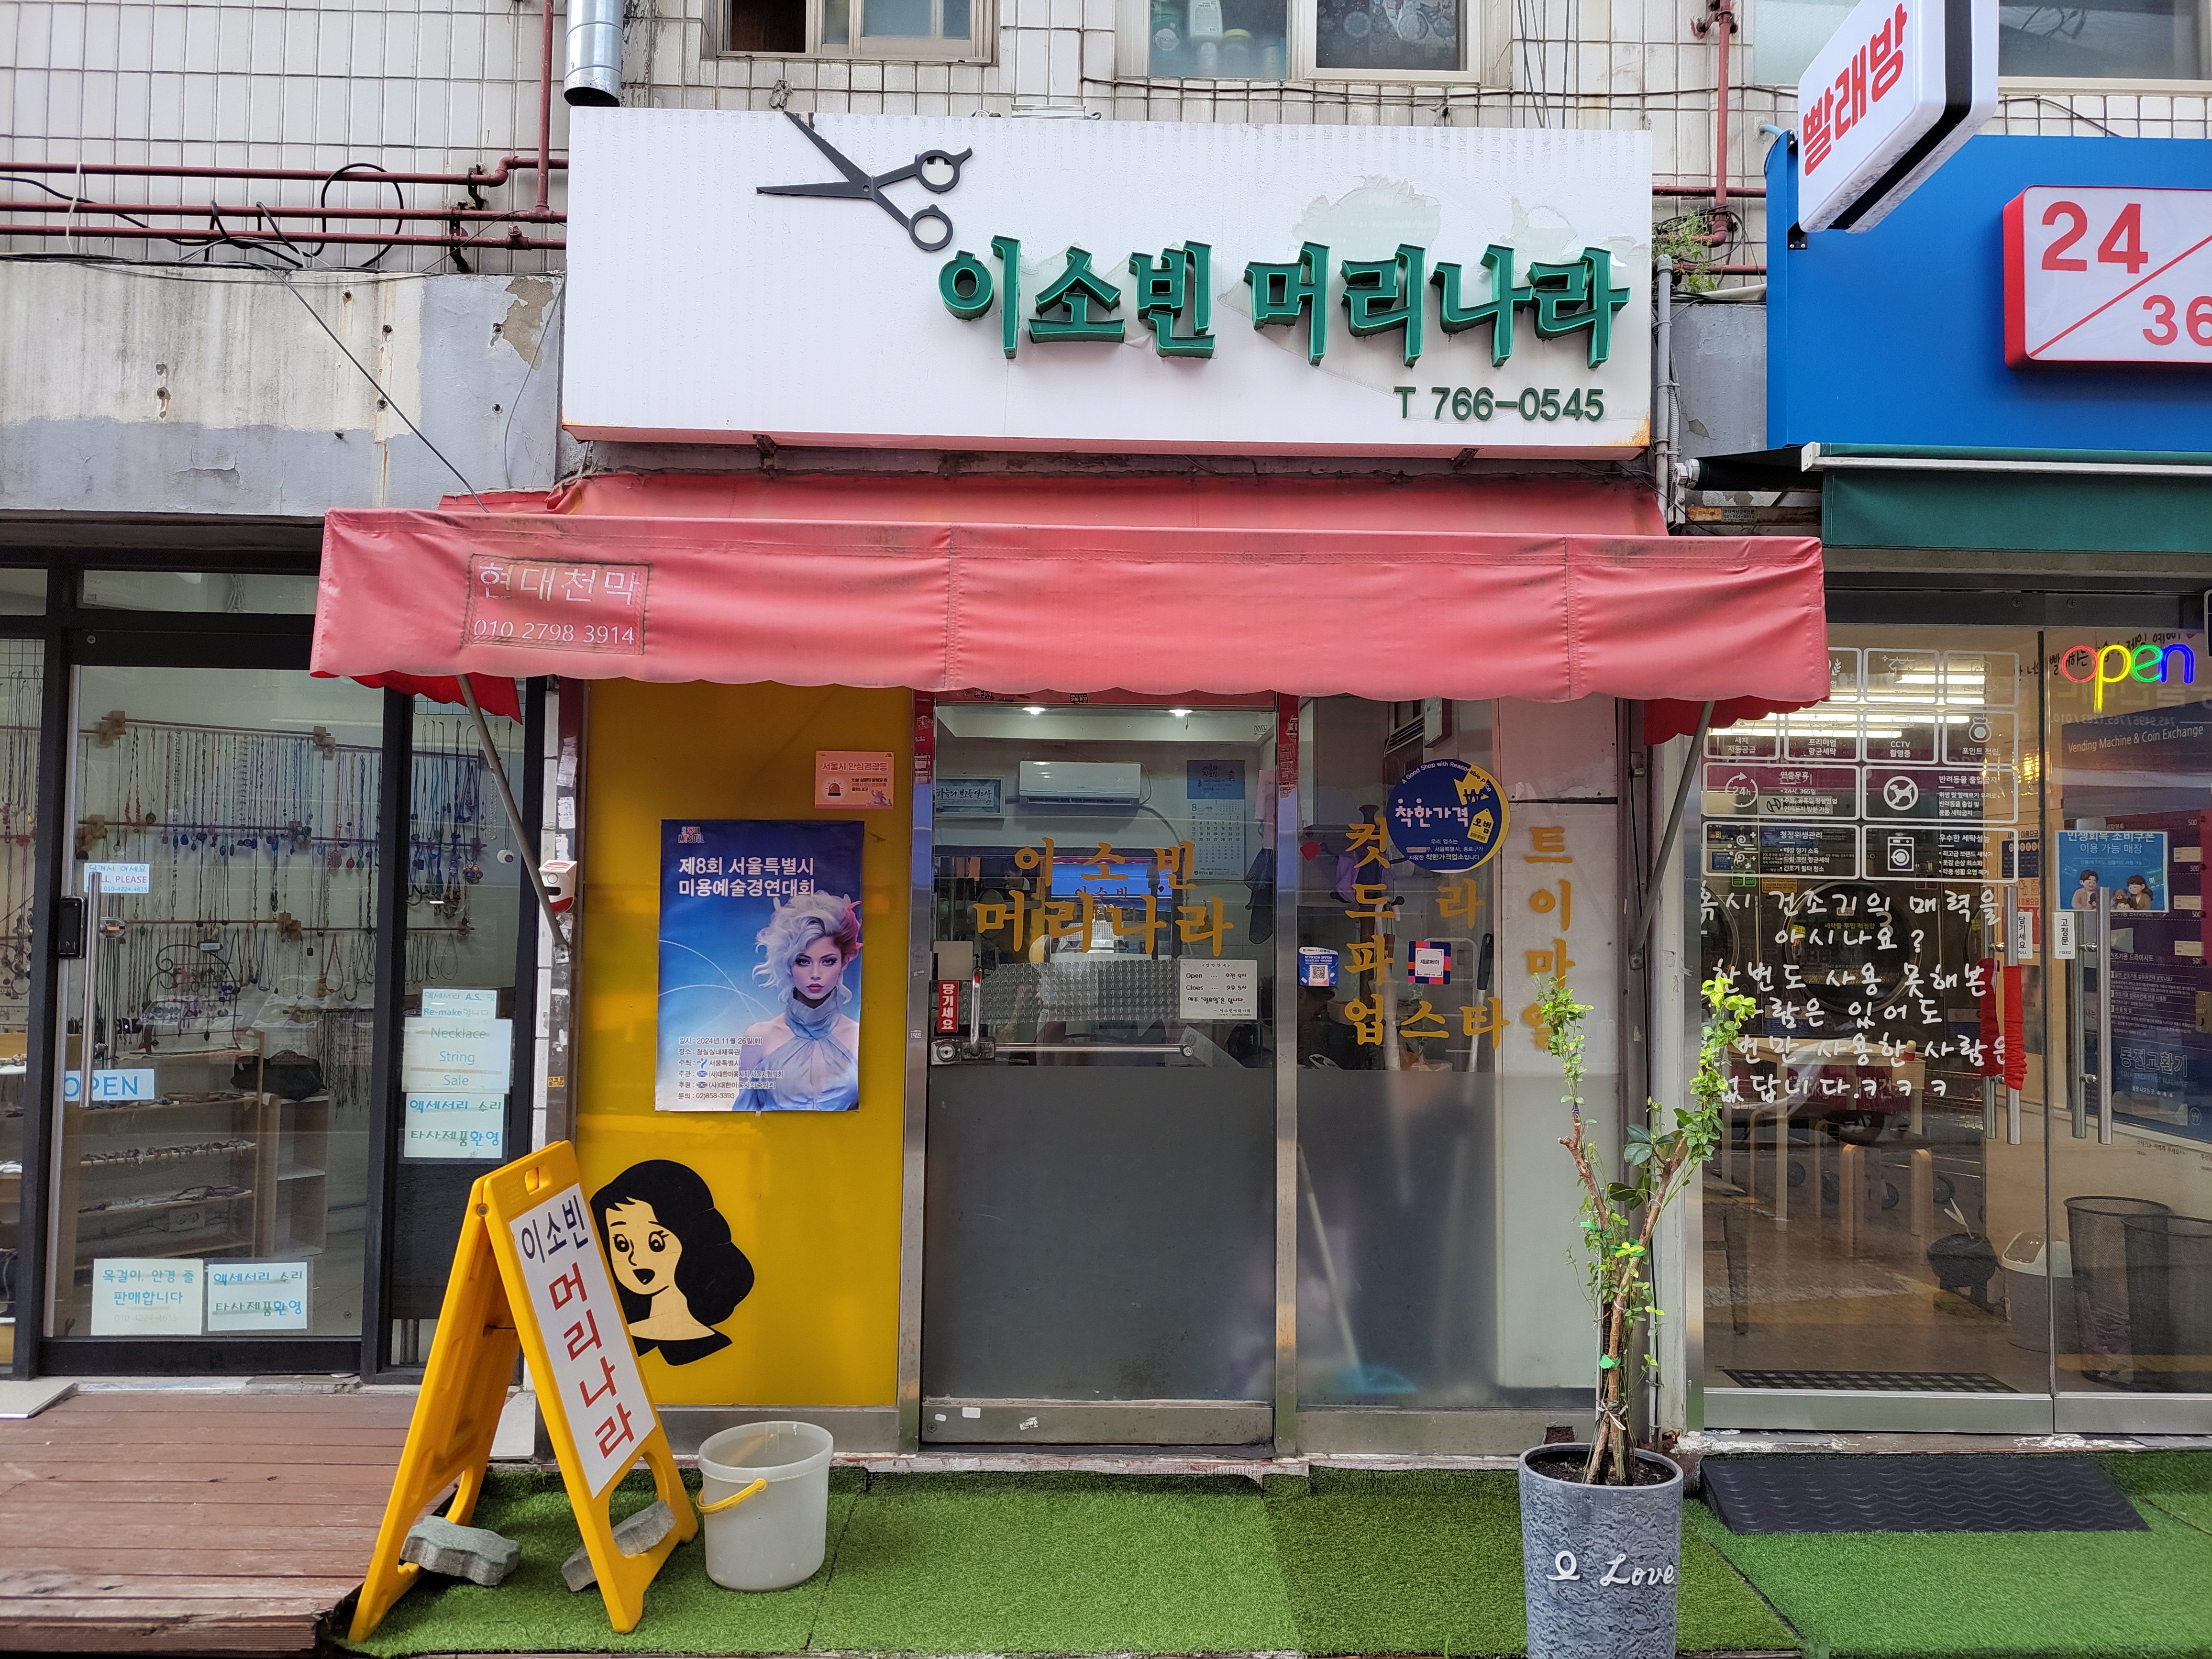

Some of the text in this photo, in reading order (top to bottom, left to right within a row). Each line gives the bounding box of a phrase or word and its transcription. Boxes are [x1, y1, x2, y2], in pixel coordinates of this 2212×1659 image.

[1803, 3, 1908, 177] 빨래방
[2041, 201, 2148, 274] 24
[939, 235, 1630, 368] 이소빈 머리나라
[1394, 387, 1605, 423] T 766-0545
[480, 563, 641, 605] 현대천막
[474, 620, 635, 644] 010 2798 3914
[2062, 644, 2195, 714] open
[1808, 738, 1837, 747] 프리미엄
[2068, 725, 2204, 753] Vending Machine & Coin Exchange
[1727, 745, 1756, 754] 자동공급
[1808, 747, 1837, 755] 항균세탁
[1890, 749, 1911, 758] 촬영중
[822, 762, 888, 771] 서울시 안심경광등
[1780, 771, 1809, 779] 연중무휴
[1405, 768, 1421, 780] Good
[1420, 762, 1436, 771] Shop
[1450, 762, 1481, 780] Reasonable
[1480, 778, 1492, 792] Price
[1939, 775, 1997, 785] 반려동물 출입금지
[1733, 786, 1751, 796] 24h
[1192, 803, 1197, 812] 8
[1395, 798, 1469, 828] 착한가격
[1472, 818, 1493, 835] 모범
[1780, 831, 1823, 840] 청정위생관리
[1939, 834, 1990, 843] 우수한 세탁성능
[2080, 843, 2143, 854] 이용 가능 매장
[678, 857, 814, 875] 제8회 서울특별시
[1015, 837, 1196, 890] 이소빈
[678, 878, 815, 897] 미용예술경연대회
[1769, 890, 1891, 917] 건조기의
[1910, 889, 2001, 926] 매력을
[973, 890, 1234, 957] 머리나라
[2060, 918, 2069, 946] 고정문
[1775, 926, 1898, 951] 아시나요
[2018, 916, 2026, 949] 당기세요
[1825, 962, 1882, 997] 사용
[1903, 962, 1986, 998] 못해본
[424, 992, 460, 1000] 액세서리
[941, 984, 956, 1030] 당기세요
[1848, 999, 1942, 1029] 있어도
[431, 1028, 487, 1039] Necklace
[738, 1037, 763, 1045] 26일(화)
[439, 1051, 475, 1065] String
[1817, 1032, 1905, 1067] 사용한
[708, 1059, 741, 1067] 서울특별시
[2120, 1046, 2188, 1078] 동전교환기
[64, 1075, 138, 1097] OEN
[443, 1074, 469, 1086] Sale
[2163, 1077, 2188, 1088] MACHINE
[409, 1100, 501, 1114] 액세서리 수리
[410, 1130, 499, 1147] 타사제품환영
[521, 1194, 589, 1263] 이소빈
[102, 1269, 194, 1284] 목걸이, 안경 줄
[213, 1271, 303, 1286] 액세서리 수리
[113, 1290, 183, 1305] 판매합니다
[215, 1300, 302, 1316] 타사제품환영
[114, 1314, 177, 1322] 010-4224-4615
[548, 1261, 635, 1459] 머리나라
[1600, 1553, 1675, 1587] Love
